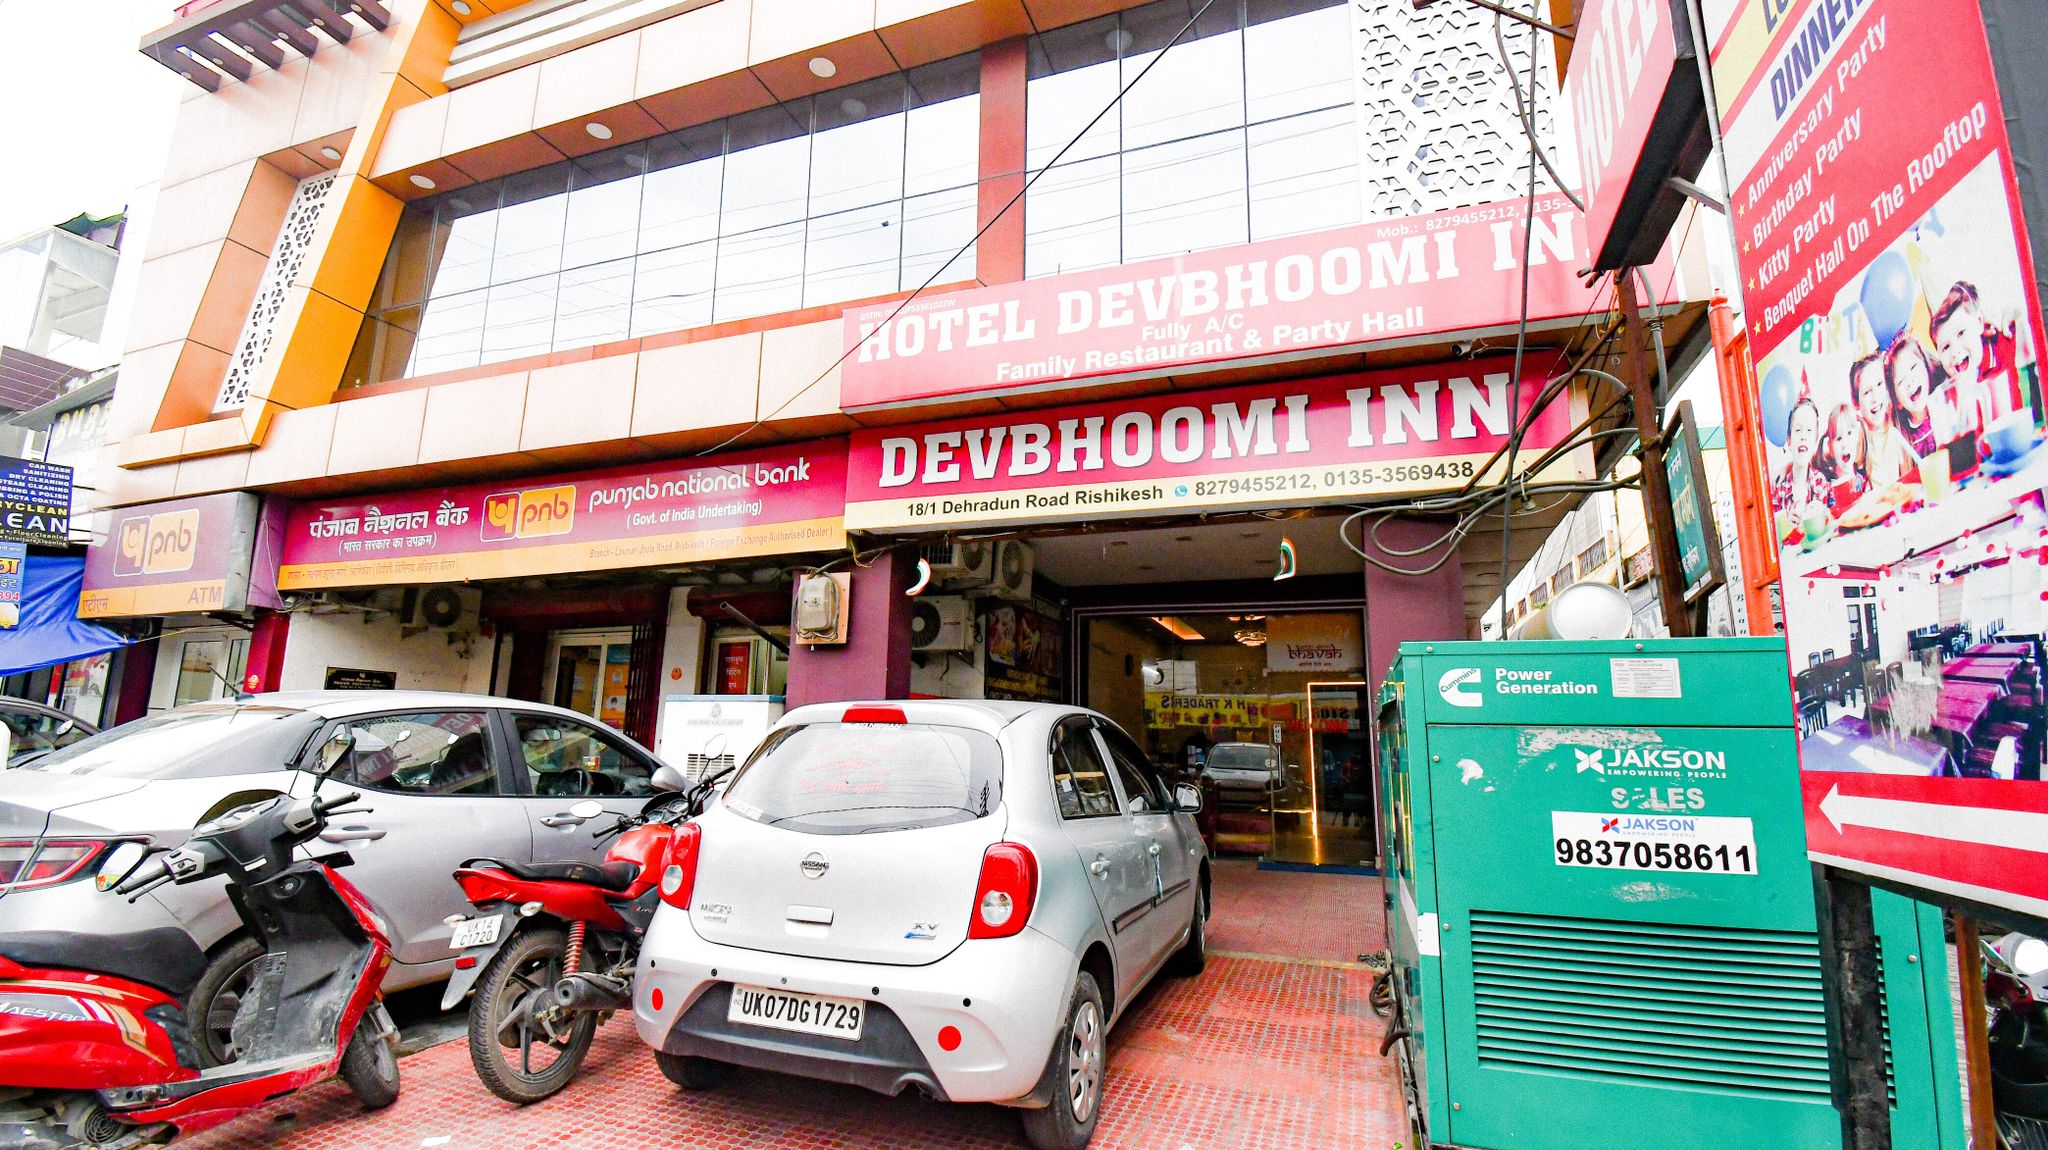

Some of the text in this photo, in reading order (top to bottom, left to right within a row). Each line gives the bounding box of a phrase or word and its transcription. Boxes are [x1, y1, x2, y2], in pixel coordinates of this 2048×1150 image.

[1748, 14, 1887, 210] Anniversary Party
[1753, 106, 1861, 250] Birthday Party
[1376, 223, 1419, 238] Mob.:
[1426, 205, 1521, 231] 8279455212,
[1764, 101, 1987, 332] Benquet Hall On The Rooftop
[1758, 193, 1836, 290] Kitty Party
[858, 211, 1588, 363] HOTEL DEVBHOOMI IN
[1142, 313, 1244, 341] Fully A/C
[996, 306, 1424, 381] Family Restaurant & Party Hall
[878, 372, 1510, 488] DEVBHOOMI INN
[23, 468, 70, 480] SANITIZING
[28, 476, 69, 487] CLEANING
[29, 462, 71, 474] CAR WASH
[28, 483, 69, 493] CLEANING
[39, 491, 69, 500] POLISH
[588, 457, 811, 513] punjab national bank
[907, 460, 1474, 516] 18/1 Dehradun Road Rishikesh 8279455212, 0135-3569438
[32, 497, 68, 506] COATING
[521, 493, 570, 532] pnb
[660, 510, 671, 523] of
[672, 505, 695, 521] India
[698, 498, 763, 520] Undertaking)
[310, 499, 470, 539] पंजाब नैशनल बैंक
[149, 518, 192, 566] pnb
[364, 538, 390, 551] सरकार
[392, 537, 403, 549] का
[187, 586, 223, 605] ATM
[1440, 667, 1477, 693] Cummins
[1495, 667, 1553, 681] Power
[1496, 681, 1598, 694] Generation
[1607, 749, 1727, 770] JAKSON
[1607, 769, 1727, 779] EMPOWERING PEOPLE
[1622, 817, 1696, 832] JAKSON
[1556, 838, 1751, 872] 9837058611
[741, 991, 860, 1031] UK07DG1729
